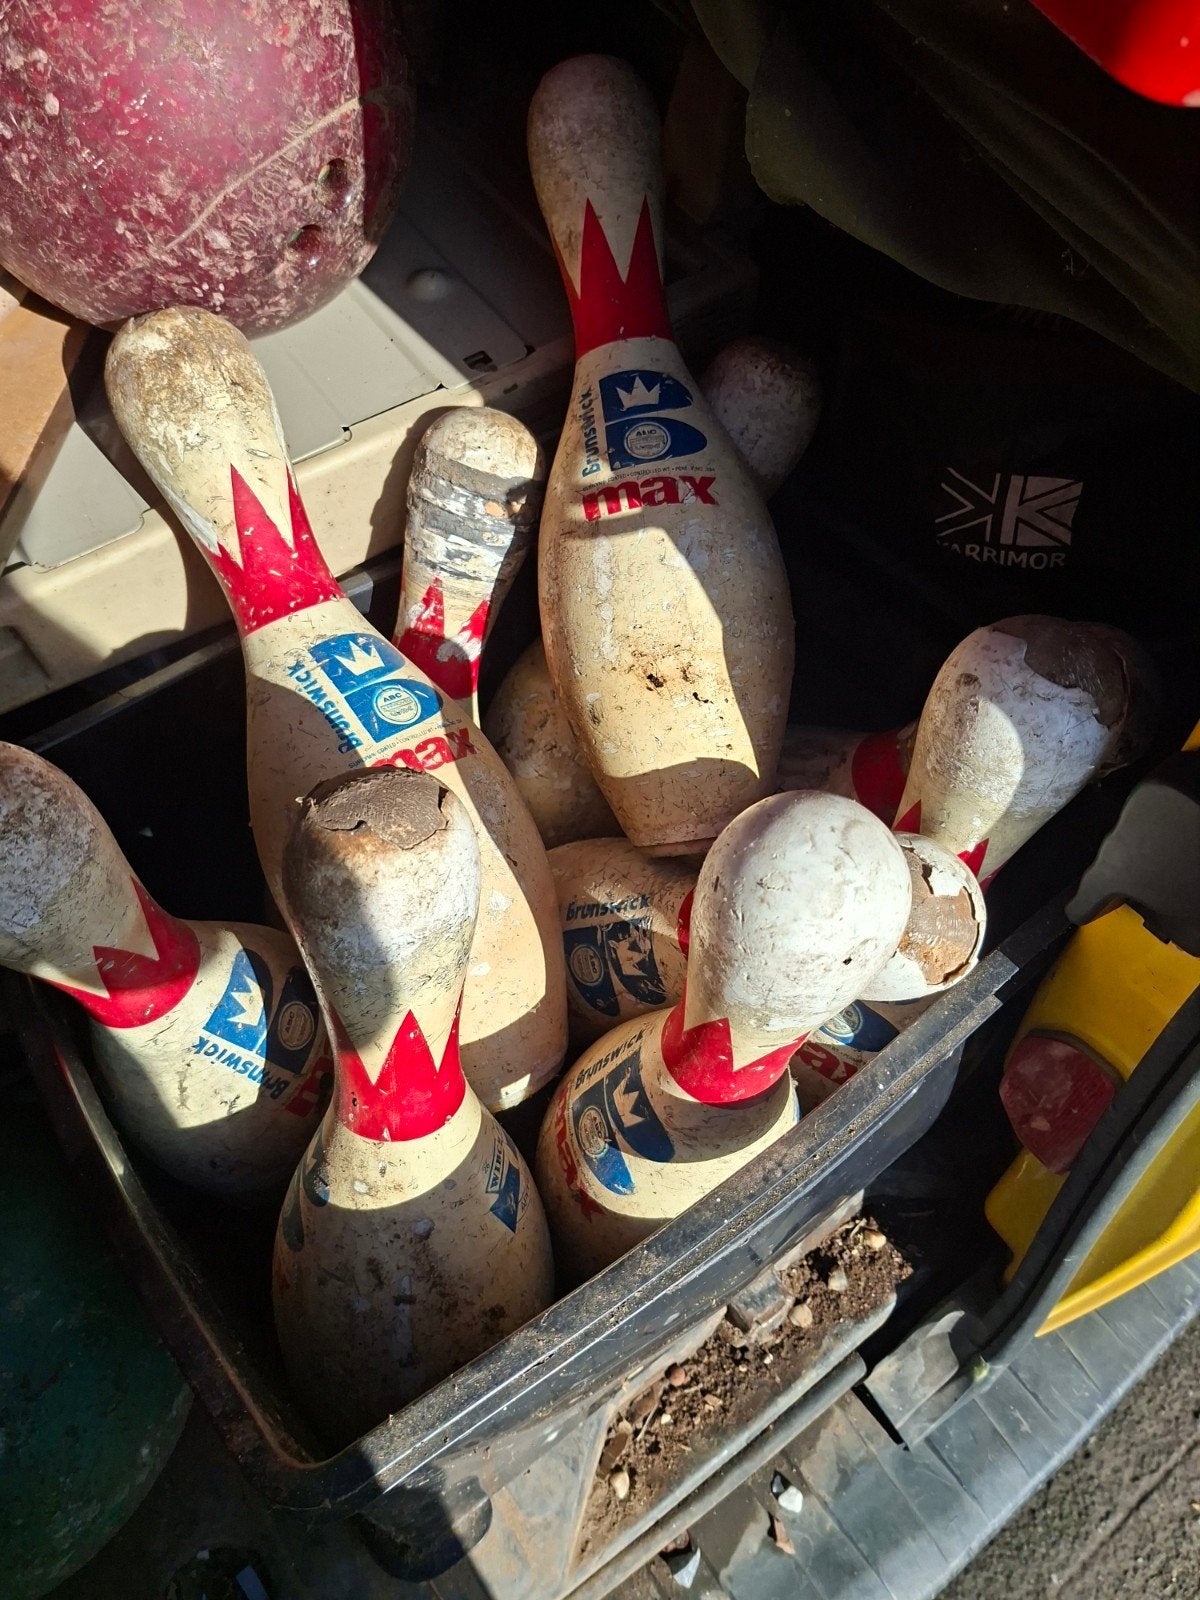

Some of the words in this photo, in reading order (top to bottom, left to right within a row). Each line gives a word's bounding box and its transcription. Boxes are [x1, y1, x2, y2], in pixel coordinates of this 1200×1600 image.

[578, 384, 601, 478] Brunswick
[582, 475, 719, 523] max
[936, 540, 1066, 570] ARRIMOR
[287, 658, 363, 754] Brunswick
[383, 692, 402, 702] ABC
[566, 894, 650, 922] Brunswick
[192, 1035, 291, 1100] Brunswick
[575, 1028, 646, 1090] Brunswick
